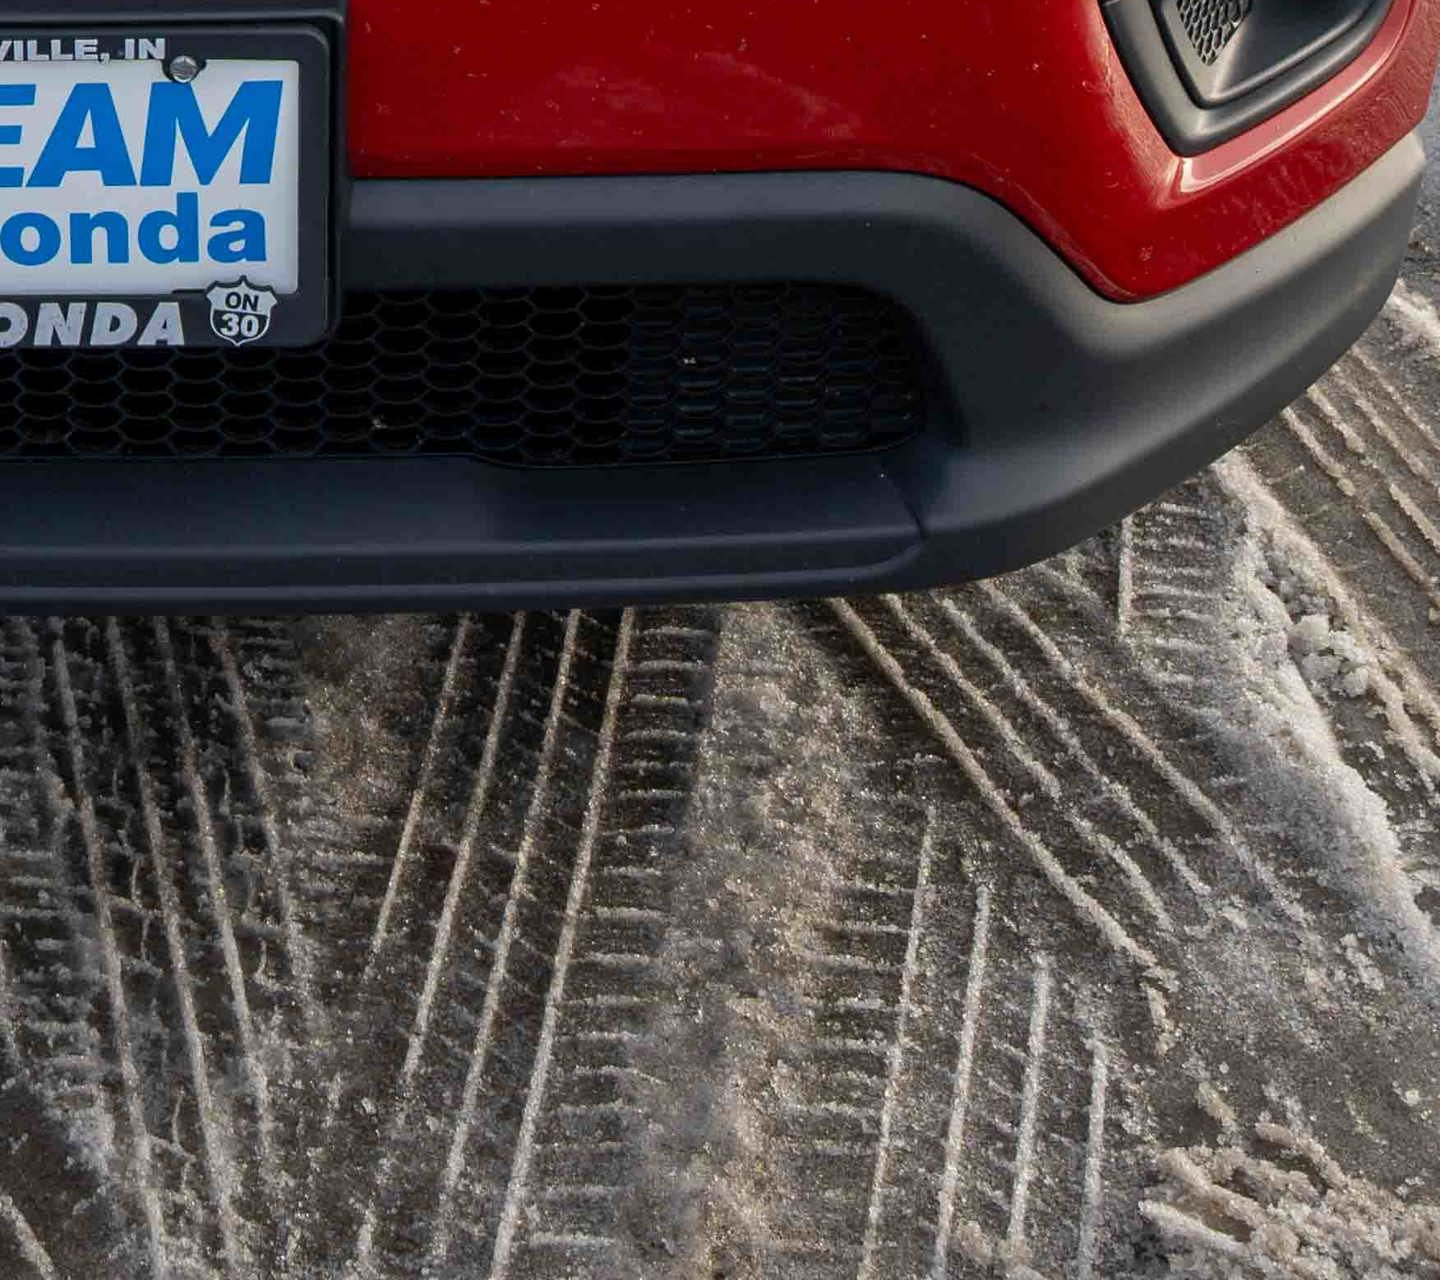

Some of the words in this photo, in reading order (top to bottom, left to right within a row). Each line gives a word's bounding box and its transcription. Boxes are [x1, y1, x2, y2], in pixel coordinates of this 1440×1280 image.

[124, 37, 165, 60] IN
[224, 291, 260, 312] ON
[219, 312, 260, 338] 30
